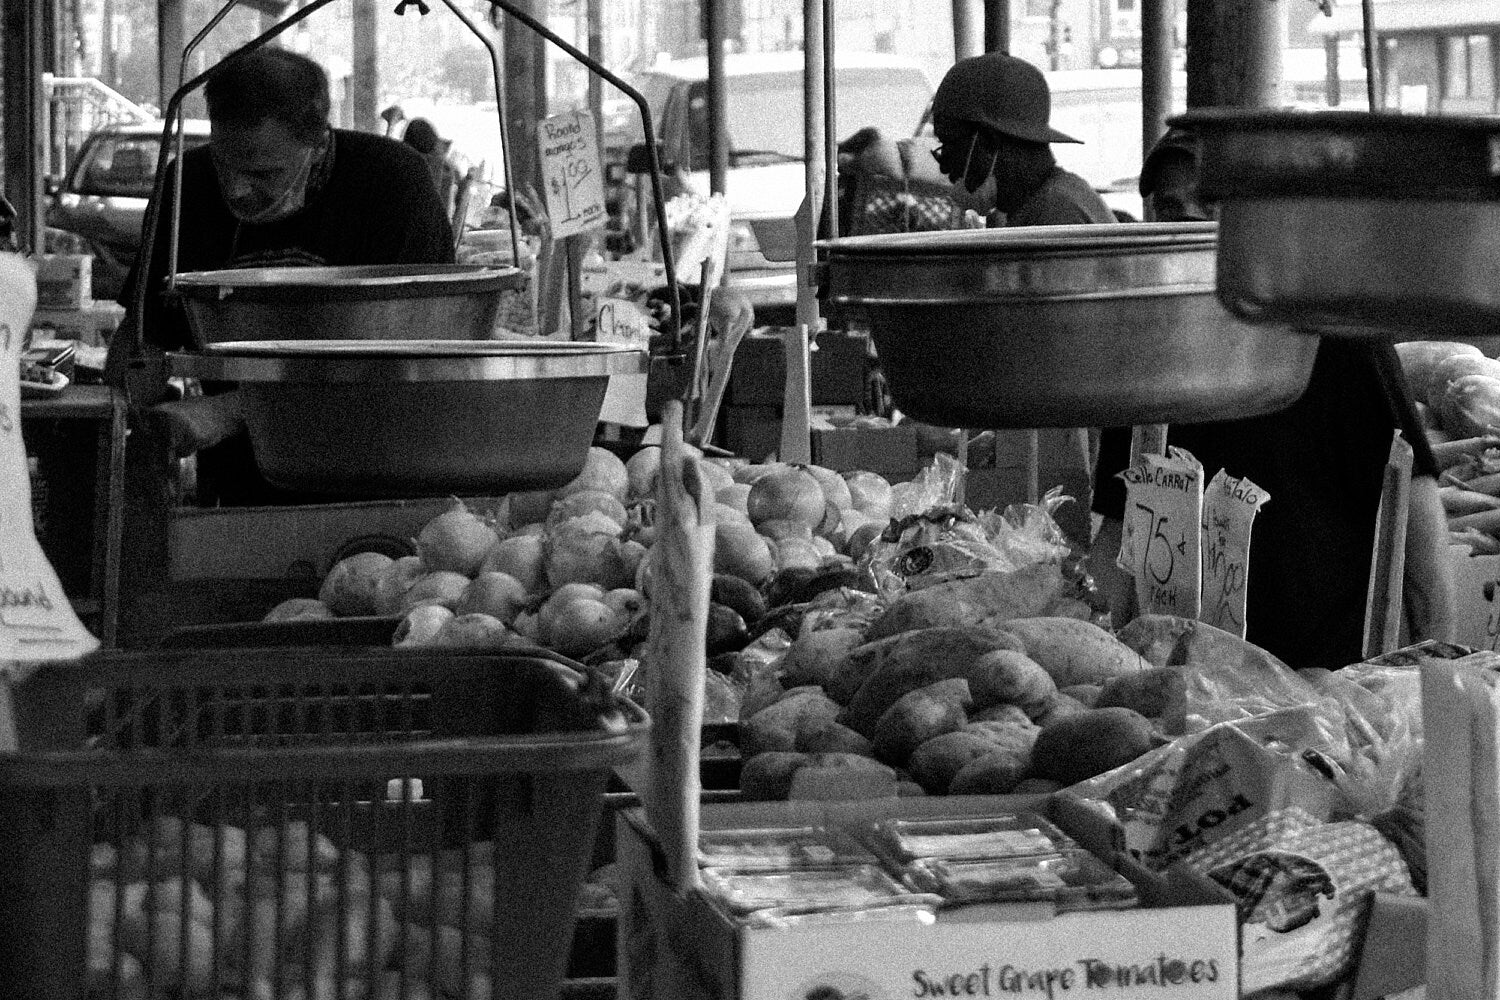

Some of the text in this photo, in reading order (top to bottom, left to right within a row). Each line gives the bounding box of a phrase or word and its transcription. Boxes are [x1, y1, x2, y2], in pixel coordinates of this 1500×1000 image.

[912, 951, 1220, 1000] Sweet Grape Tomatoes
